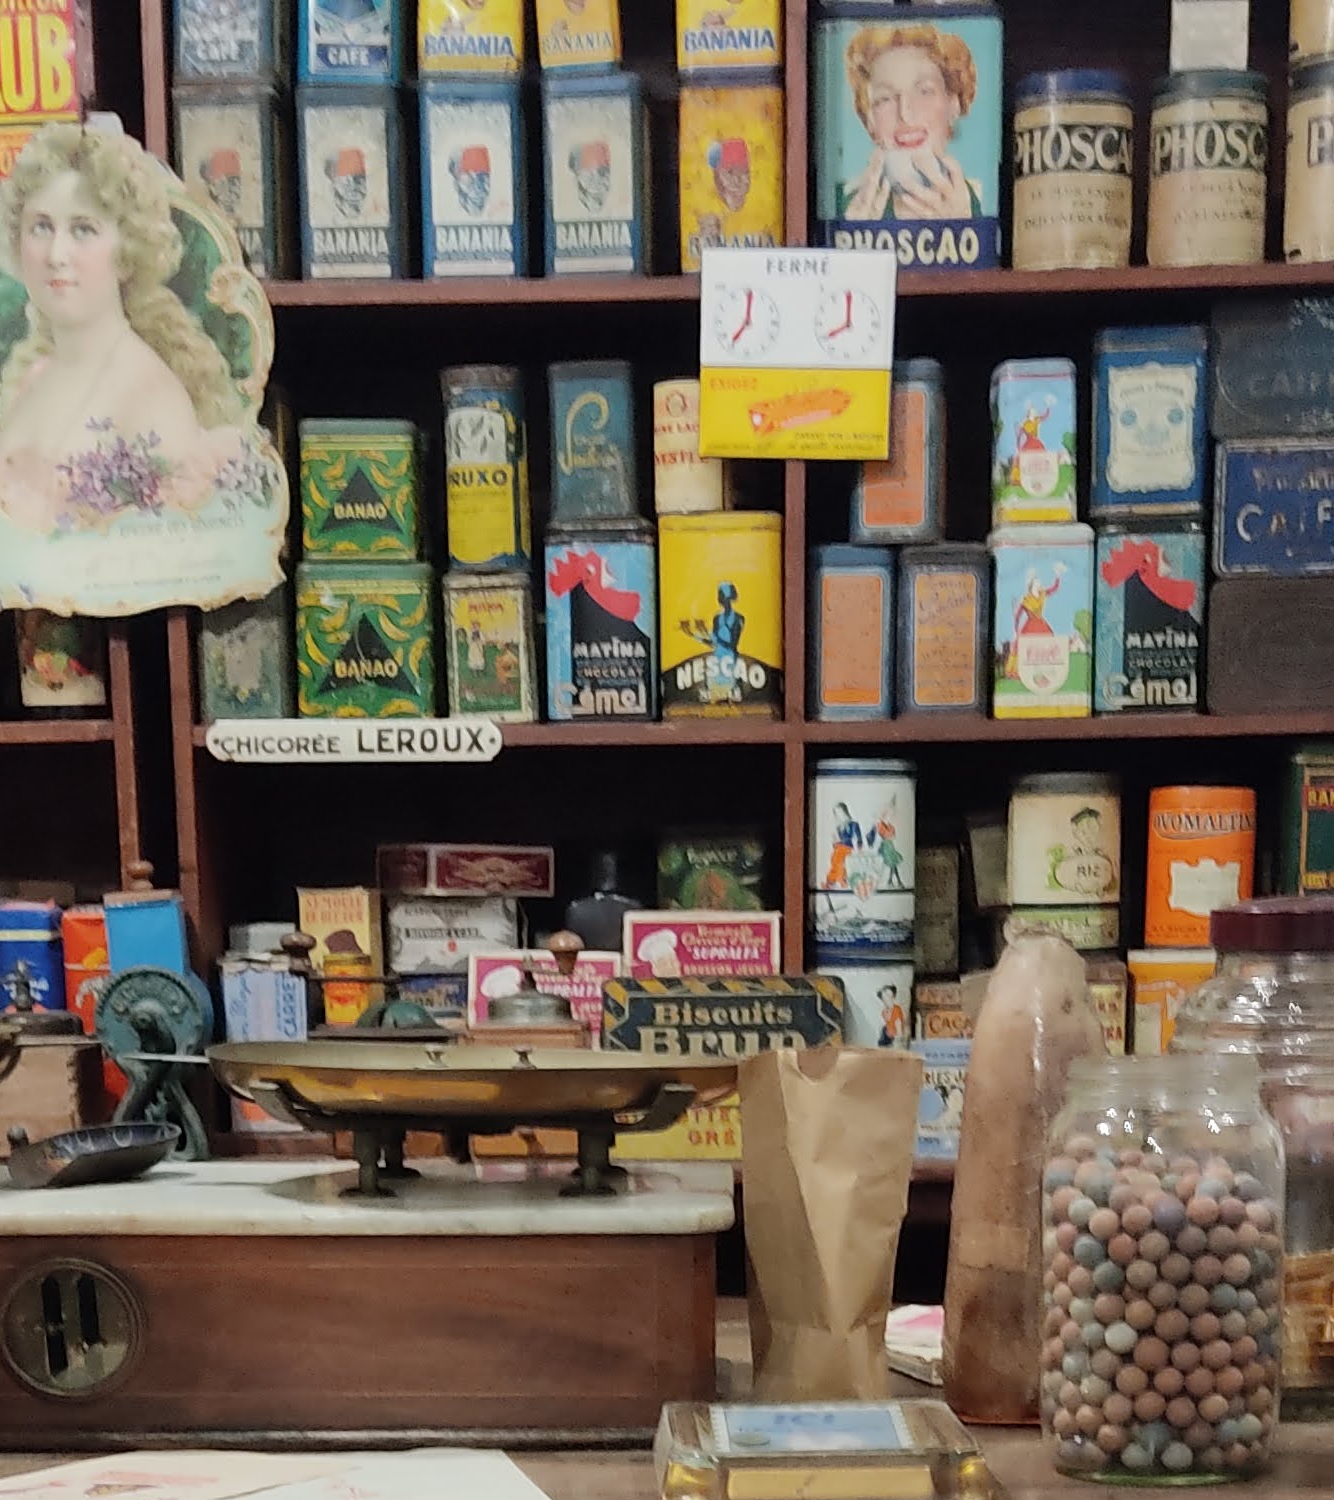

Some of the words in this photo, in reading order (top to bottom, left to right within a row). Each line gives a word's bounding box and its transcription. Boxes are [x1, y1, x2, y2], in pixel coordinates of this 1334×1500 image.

[424, 35, 515, 58] BANANIA
[542, 31, 620, 53] BANANIA
[683, 29, 776, 53] BANANIA
[313, 225, 389, 253] BANANIA
[435, 224, 512, 252] BANANIA
[556, 222, 632, 251] BANANIA
[334, 502, 388, 523] BANAO
[334, 657, 399, 681] BANAO
[677, 655, 767, 691] NESCAO
[357, 727, 486, 756] LEROUX
[653, 1000, 794, 1026] Biscuits
[637, 1025, 807, 1057] Brun
